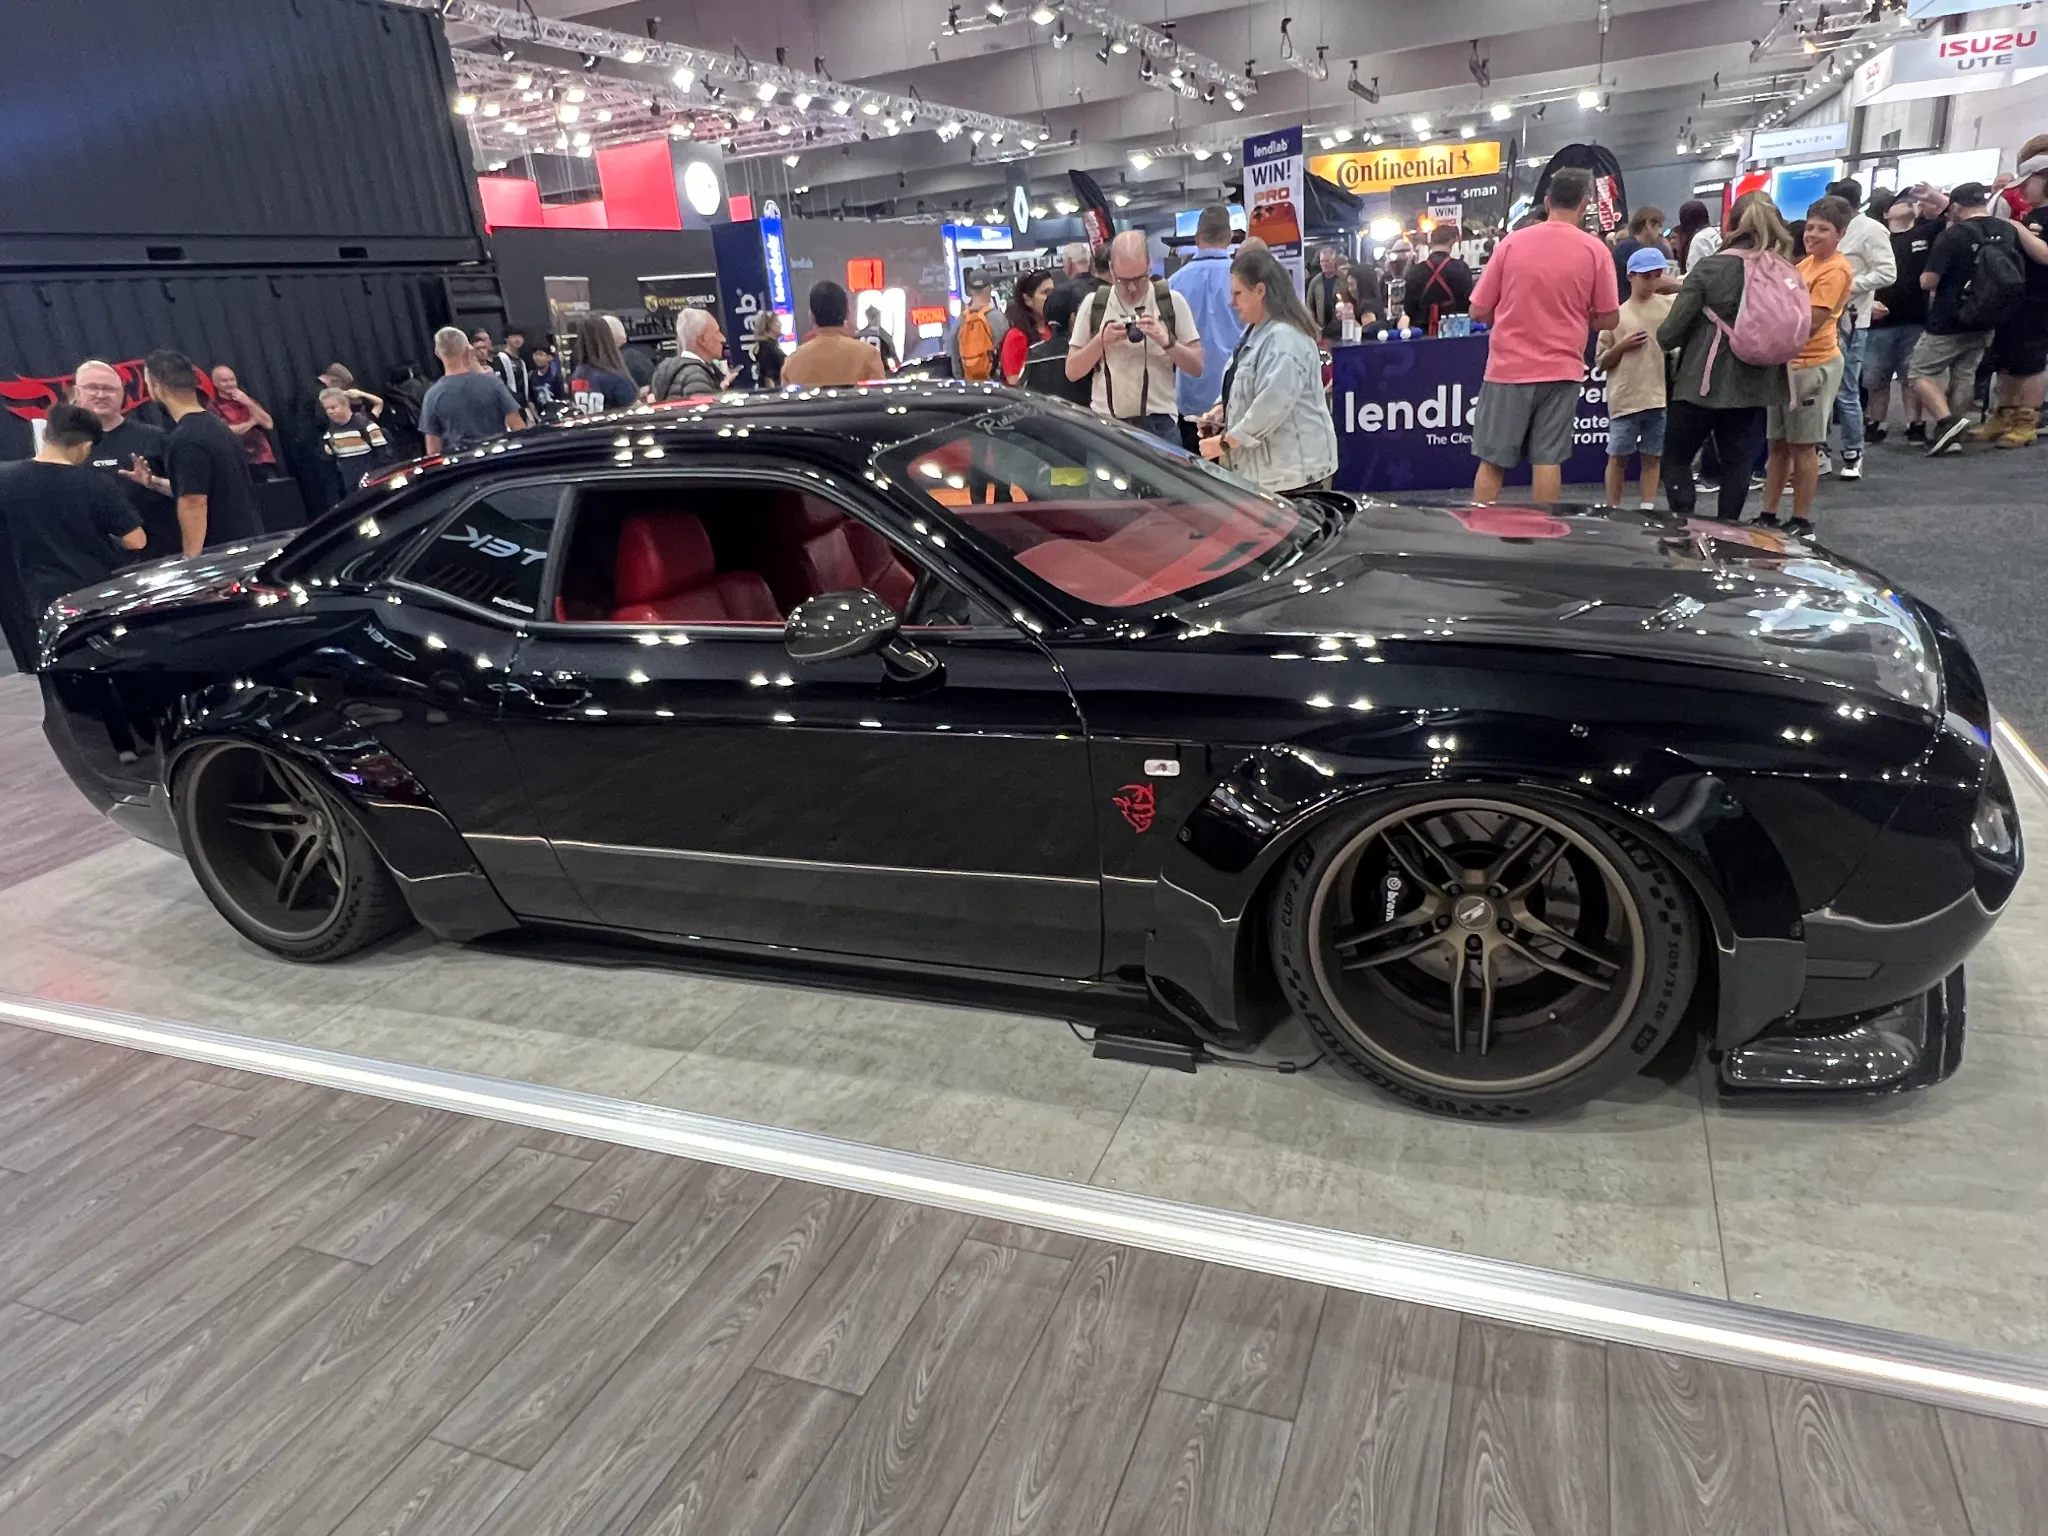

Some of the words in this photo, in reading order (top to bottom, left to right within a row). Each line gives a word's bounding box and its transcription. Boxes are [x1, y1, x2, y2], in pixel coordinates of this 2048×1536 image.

[1939, 30, 2037, 58] ISUZU
[1957, 53, 2013, 71] UTE
[1253, 138, 1288, 158] lendlab
[1252, 160, 1291, 186] WIN!
[1337, 152, 1455, 190] Continental
[1254, 187, 1290, 205] PRO
[1434, 206, 1457, 217] WIN!
[1426, 433, 1448, 445] The
[1573, 432, 1611, 445] rom
[1281, 891, 1294, 927] CUP
